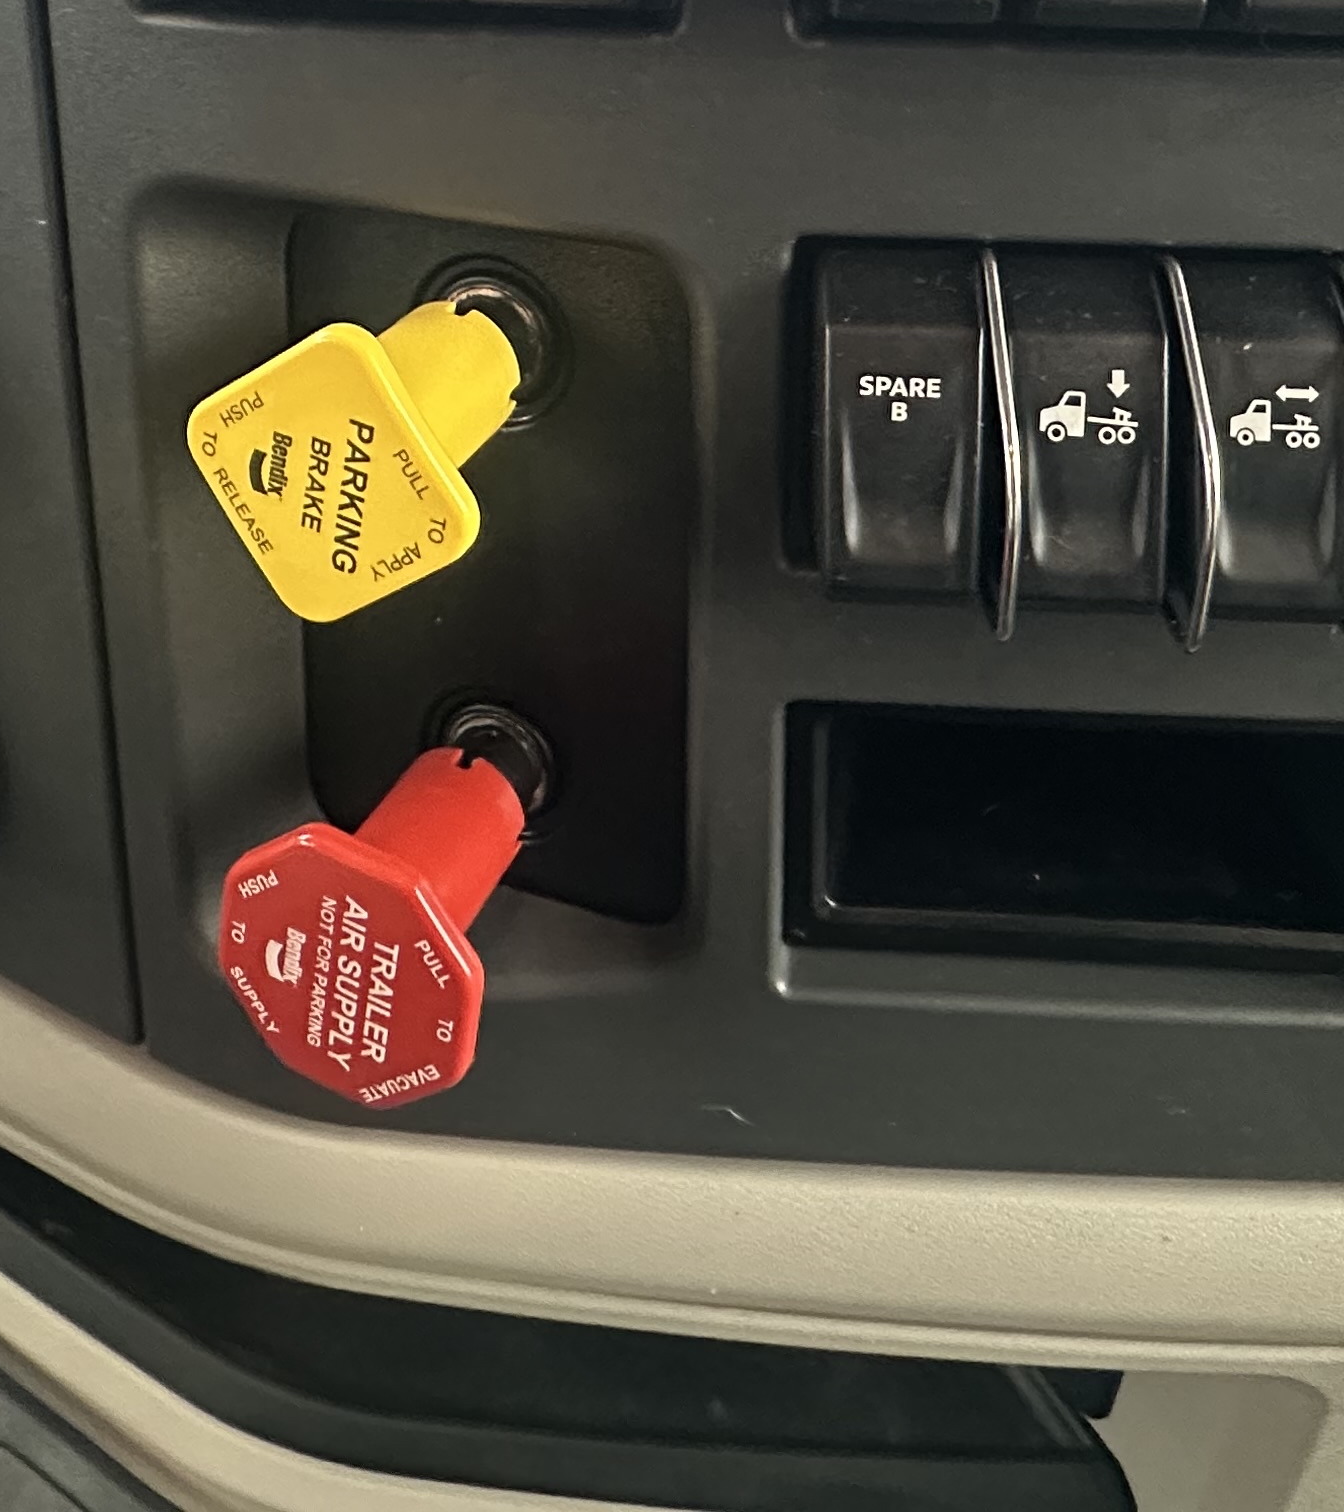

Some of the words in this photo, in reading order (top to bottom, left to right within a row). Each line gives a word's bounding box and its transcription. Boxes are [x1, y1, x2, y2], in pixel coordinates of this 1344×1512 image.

[219, 391, 264, 428] PUSH
[859, 375, 942, 398] SPARE
[891, 401, 908, 422] B
[201, 430, 218, 457] TO
[267, 430, 293, 501] Bendix
[301, 436, 332, 533] BRAKE
[331, 418, 375, 574] PARKING
[393, 448, 431, 501] PULL
[213, 467, 273, 554] RELEASE
[427, 517, 447, 545] TO
[371, 541, 422, 582] APPLY
[237, 868, 279, 899] PUSH
[231, 920, 246, 945] TO
[319, 895, 337, 935] NOT
[337, 895, 369, 954] AIR
[282, 926, 306, 988] Bendix
[315, 935, 332, 973] FOR
[414, 939, 453, 990] PULL
[230, 966, 281, 1034] SUPPLY
[306, 972, 328, 1048] PARKING
[327, 954, 362, 1072] SUPPLY
[361, 941, 400, 1064] TRAILER
[436, 1019, 454, 1043] TO
[358, 1064, 441, 1104] EVACUATE
